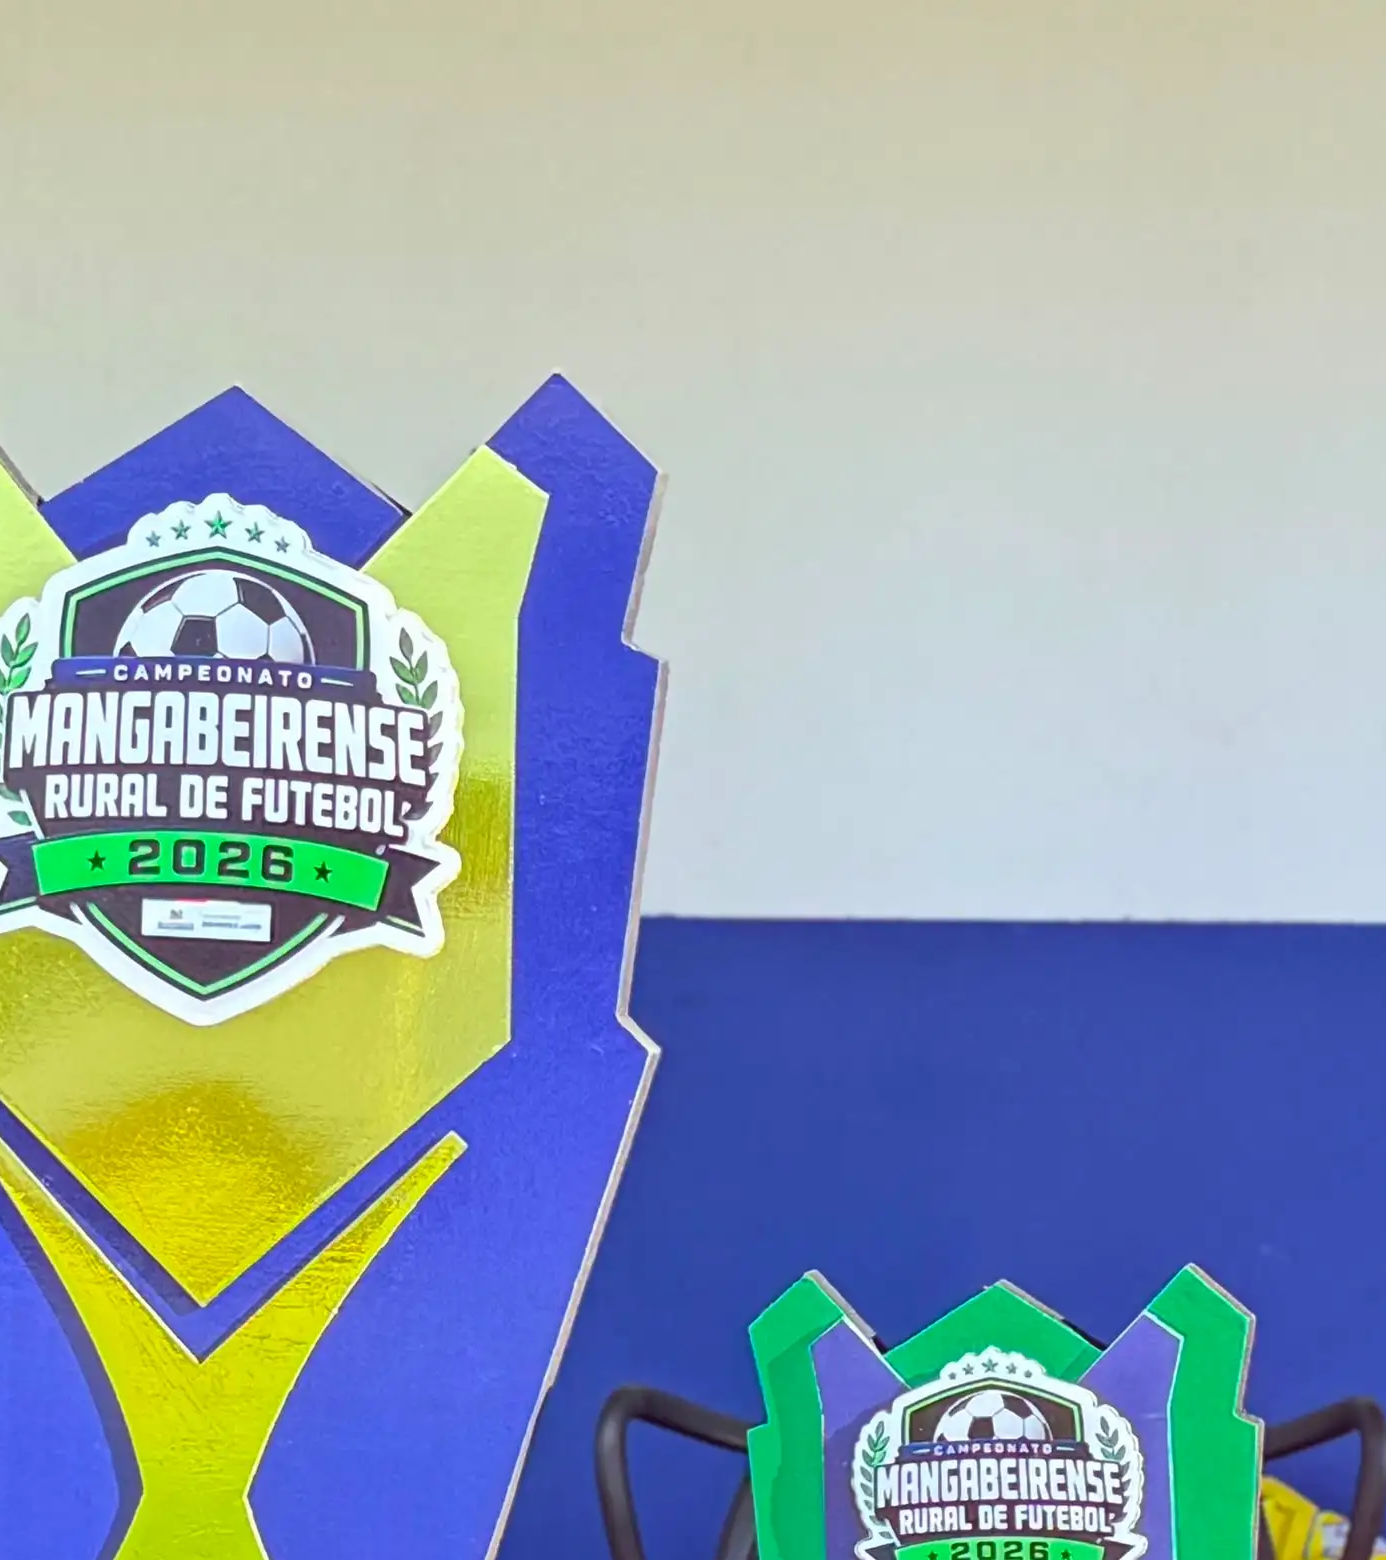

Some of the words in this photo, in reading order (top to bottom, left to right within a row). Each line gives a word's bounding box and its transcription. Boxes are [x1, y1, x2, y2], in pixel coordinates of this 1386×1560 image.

[113, 664, 313, 689] CAMPEONATO
[9, 690, 428, 787] MANGABEIRENSE
[45, 774, 167, 819] RURAL
[179, 774, 229, 820] DE
[241, 777, 406, 836] FUTEBOL
[128, 838, 295, 883] 2026
[933, 1442, 1052, 1456] CAMPEONATO
[876, 1457, 1124, 1510] MANGABEIRENSE
[899, 1506, 972, 1535] RURAL
[978, 1504, 1008, 1531] DE
[1015, 1504, 1113, 1534] FUTEBOL
